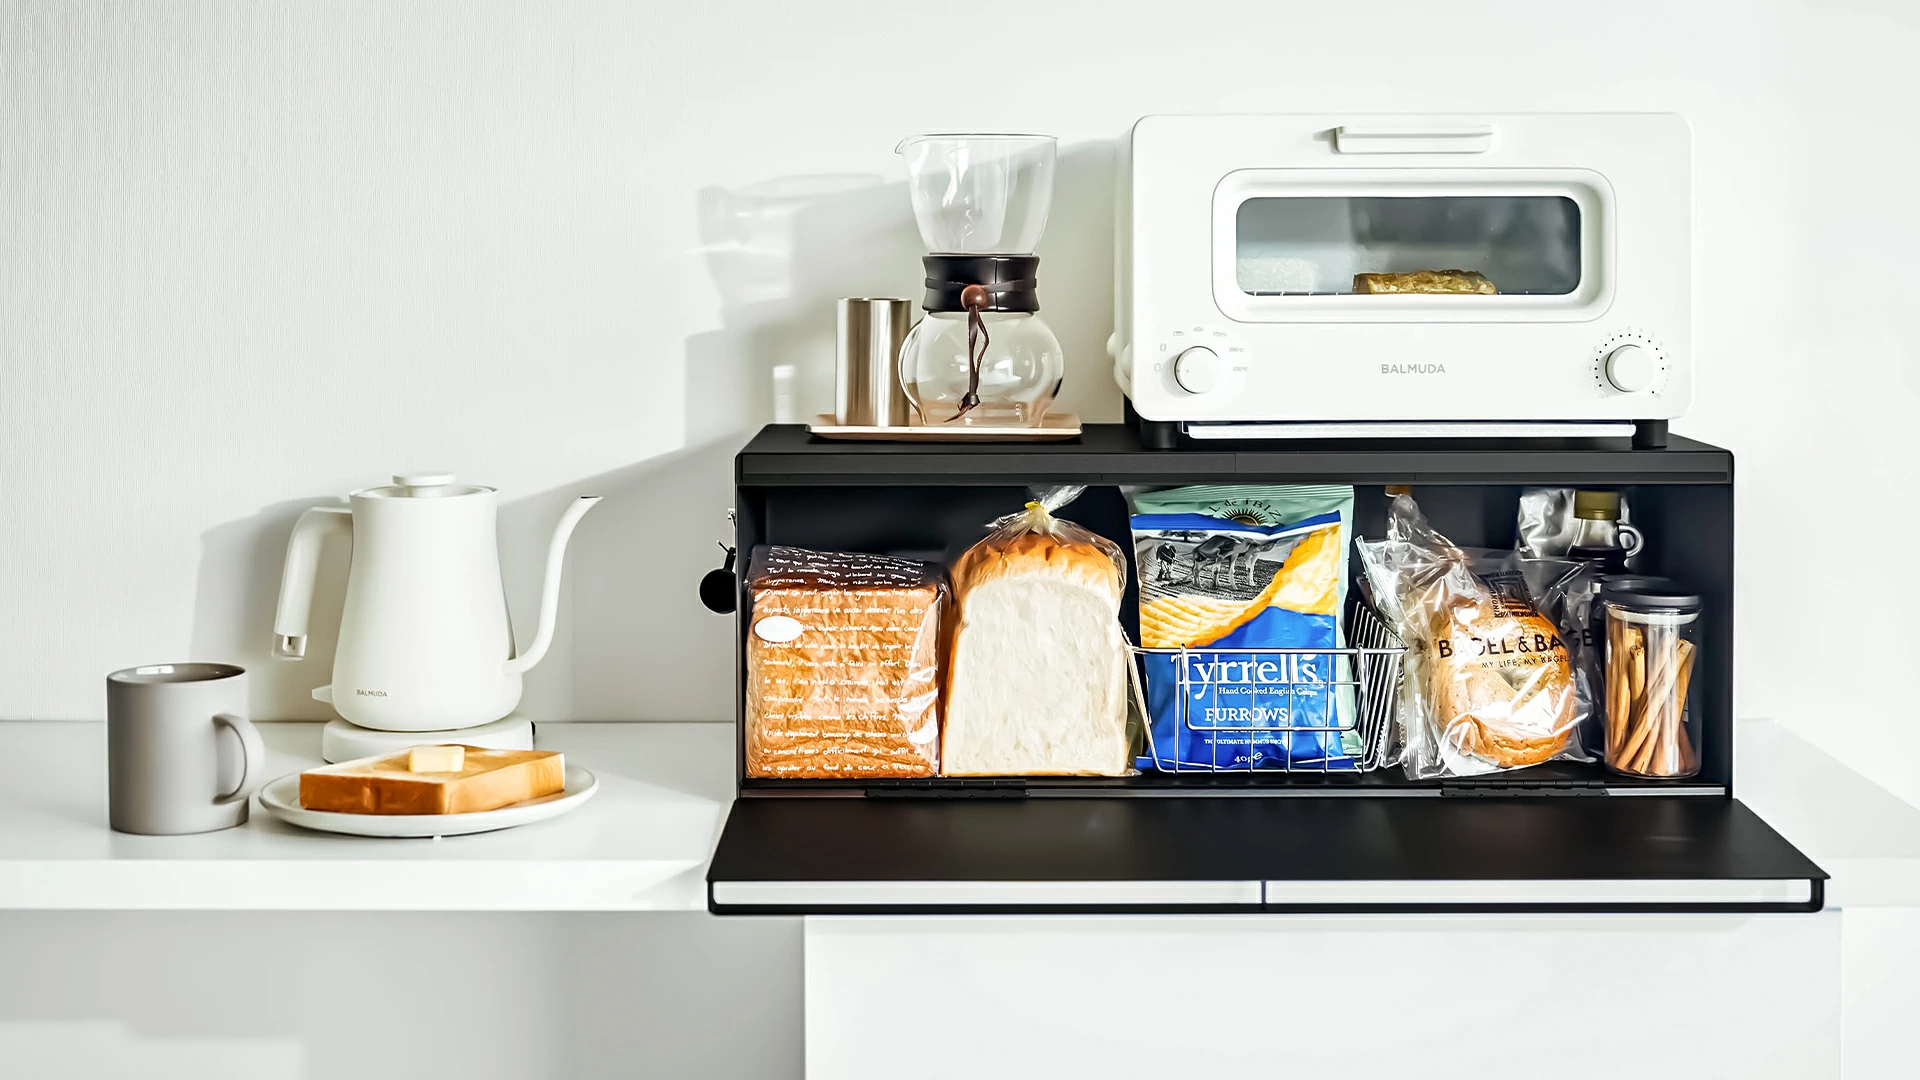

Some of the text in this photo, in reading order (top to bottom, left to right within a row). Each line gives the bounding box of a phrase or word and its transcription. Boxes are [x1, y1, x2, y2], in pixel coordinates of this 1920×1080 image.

[1381, 363, 1446, 375] BALMUDA
[356, 688, 388, 697] BALMUDA
[1219, 687, 1239, 695] Hand
[1240, 687, 1267, 695] Coked
[1204, 707, 1289, 722] FURROWS
